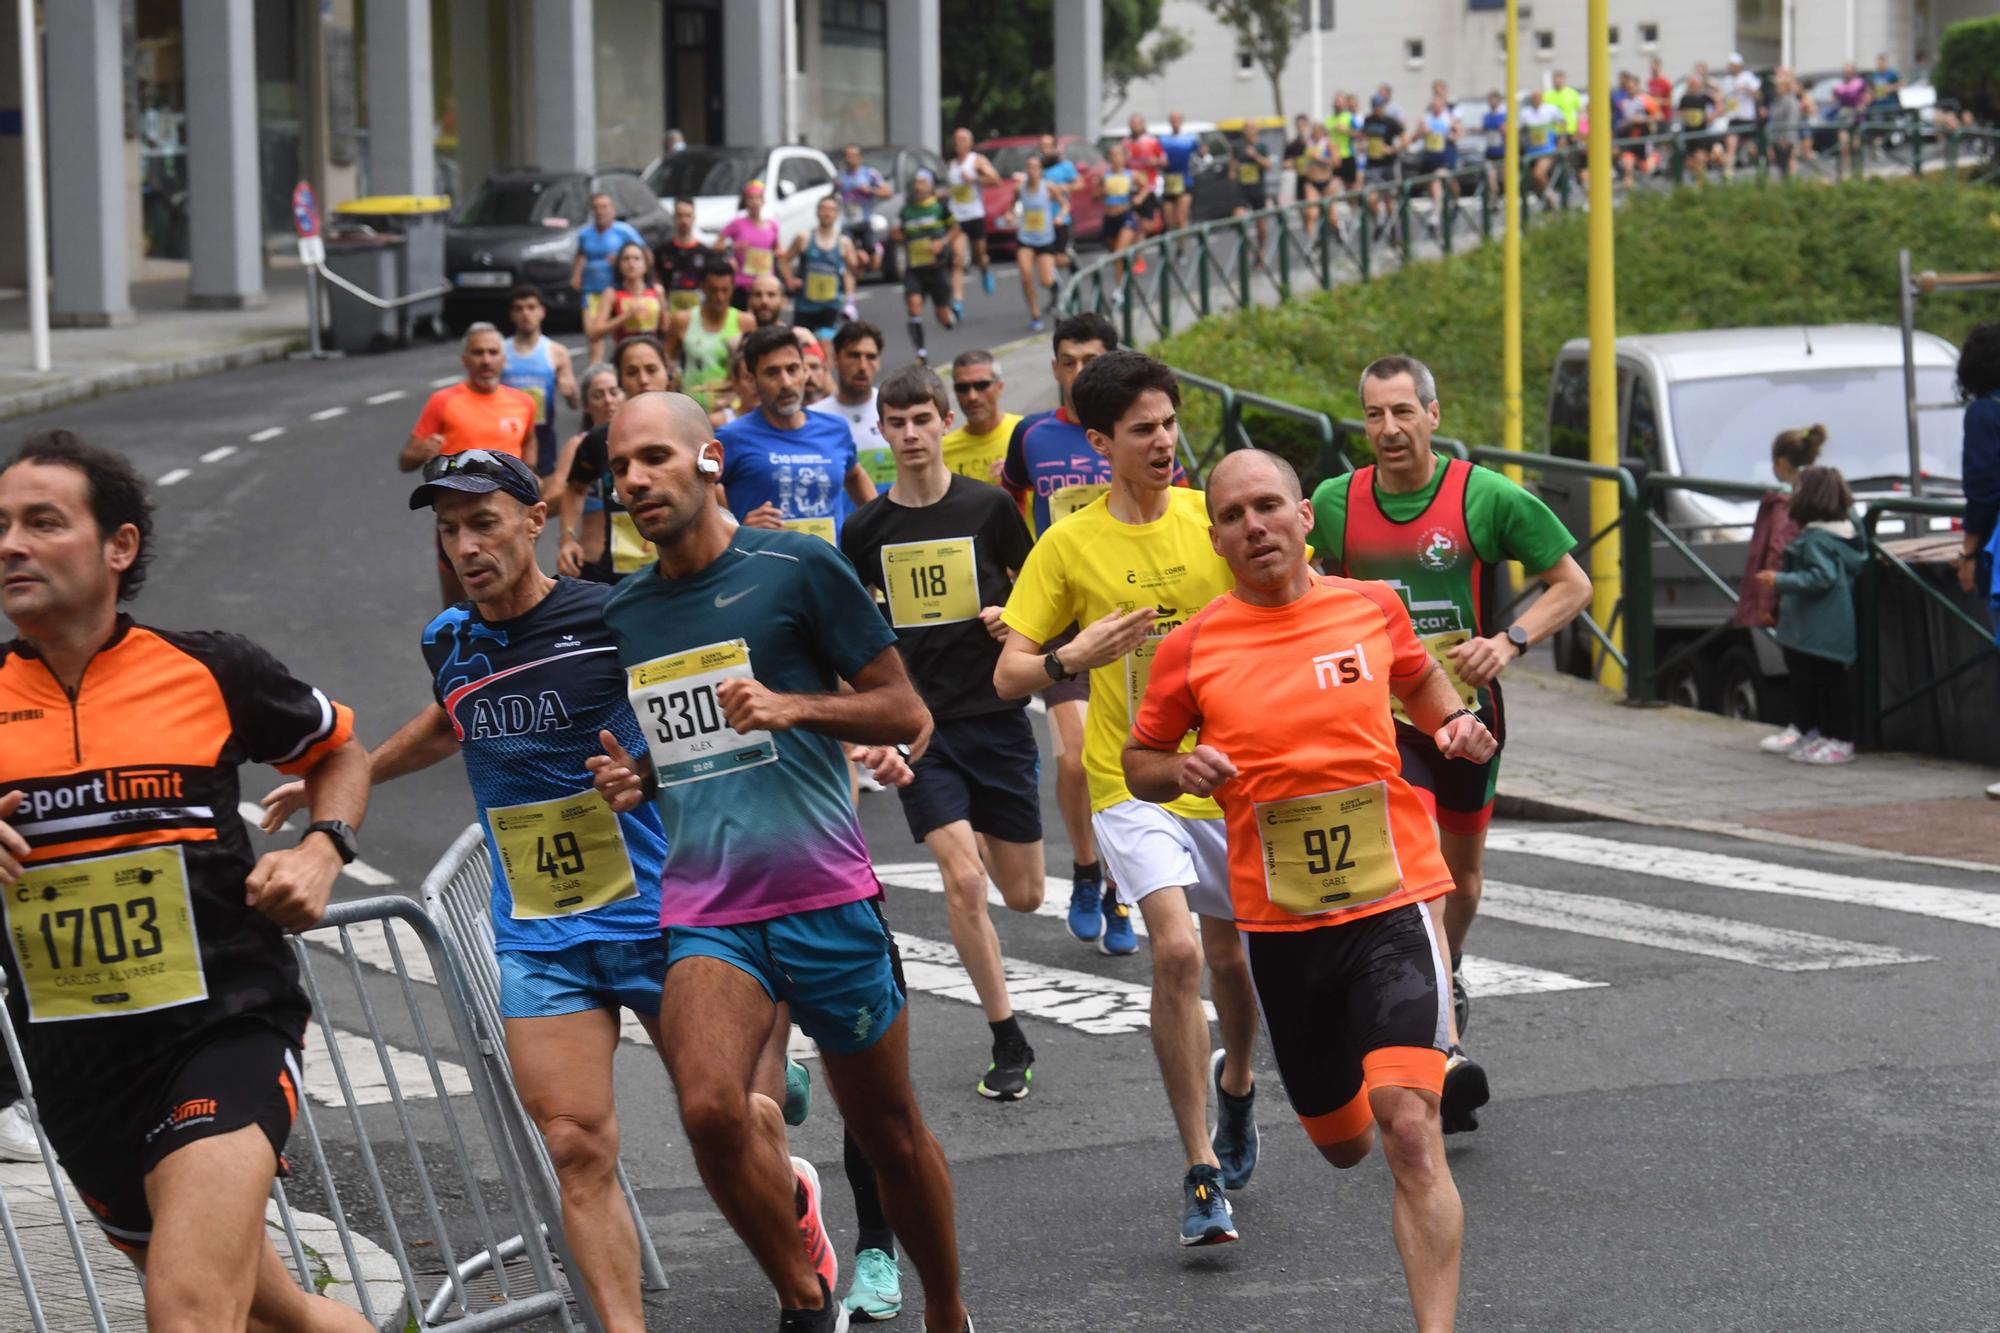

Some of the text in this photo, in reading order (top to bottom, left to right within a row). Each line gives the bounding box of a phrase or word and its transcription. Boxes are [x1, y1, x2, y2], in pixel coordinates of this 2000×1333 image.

[911, 565, 947, 598] 118
[471, 690, 572, 740] ADA
[536, 831, 585, 879] 49
[1304, 824, 1356, 875] 92
[1322, 876, 1347, 888] GABI
[39, 896, 163, 970] 1703
[55, 972, 101, 988] CARLOS
